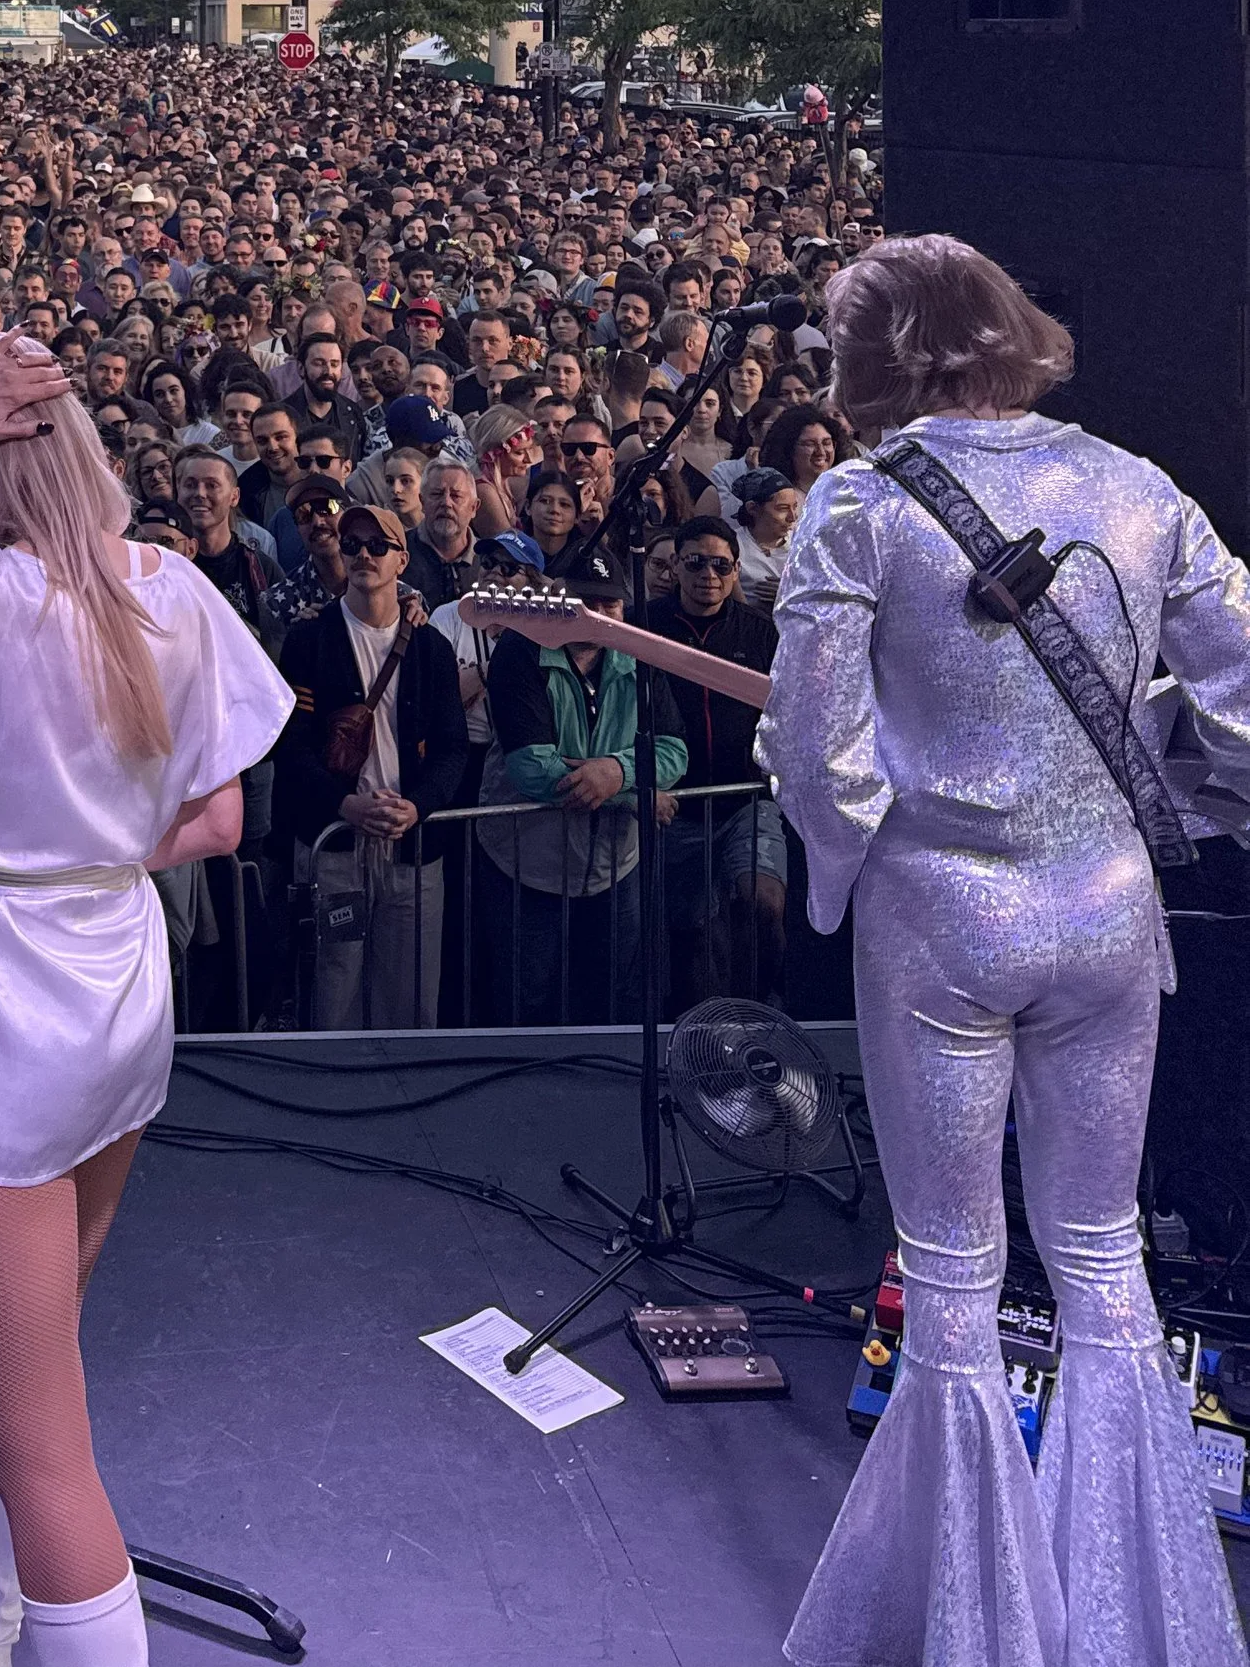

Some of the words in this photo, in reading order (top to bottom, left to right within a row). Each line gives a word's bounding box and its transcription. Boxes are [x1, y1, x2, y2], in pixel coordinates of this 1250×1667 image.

[280, 43, 313, 59] STOP
[426, 405, 440, 421] LA
[332, 910, 350, 922] SEM
